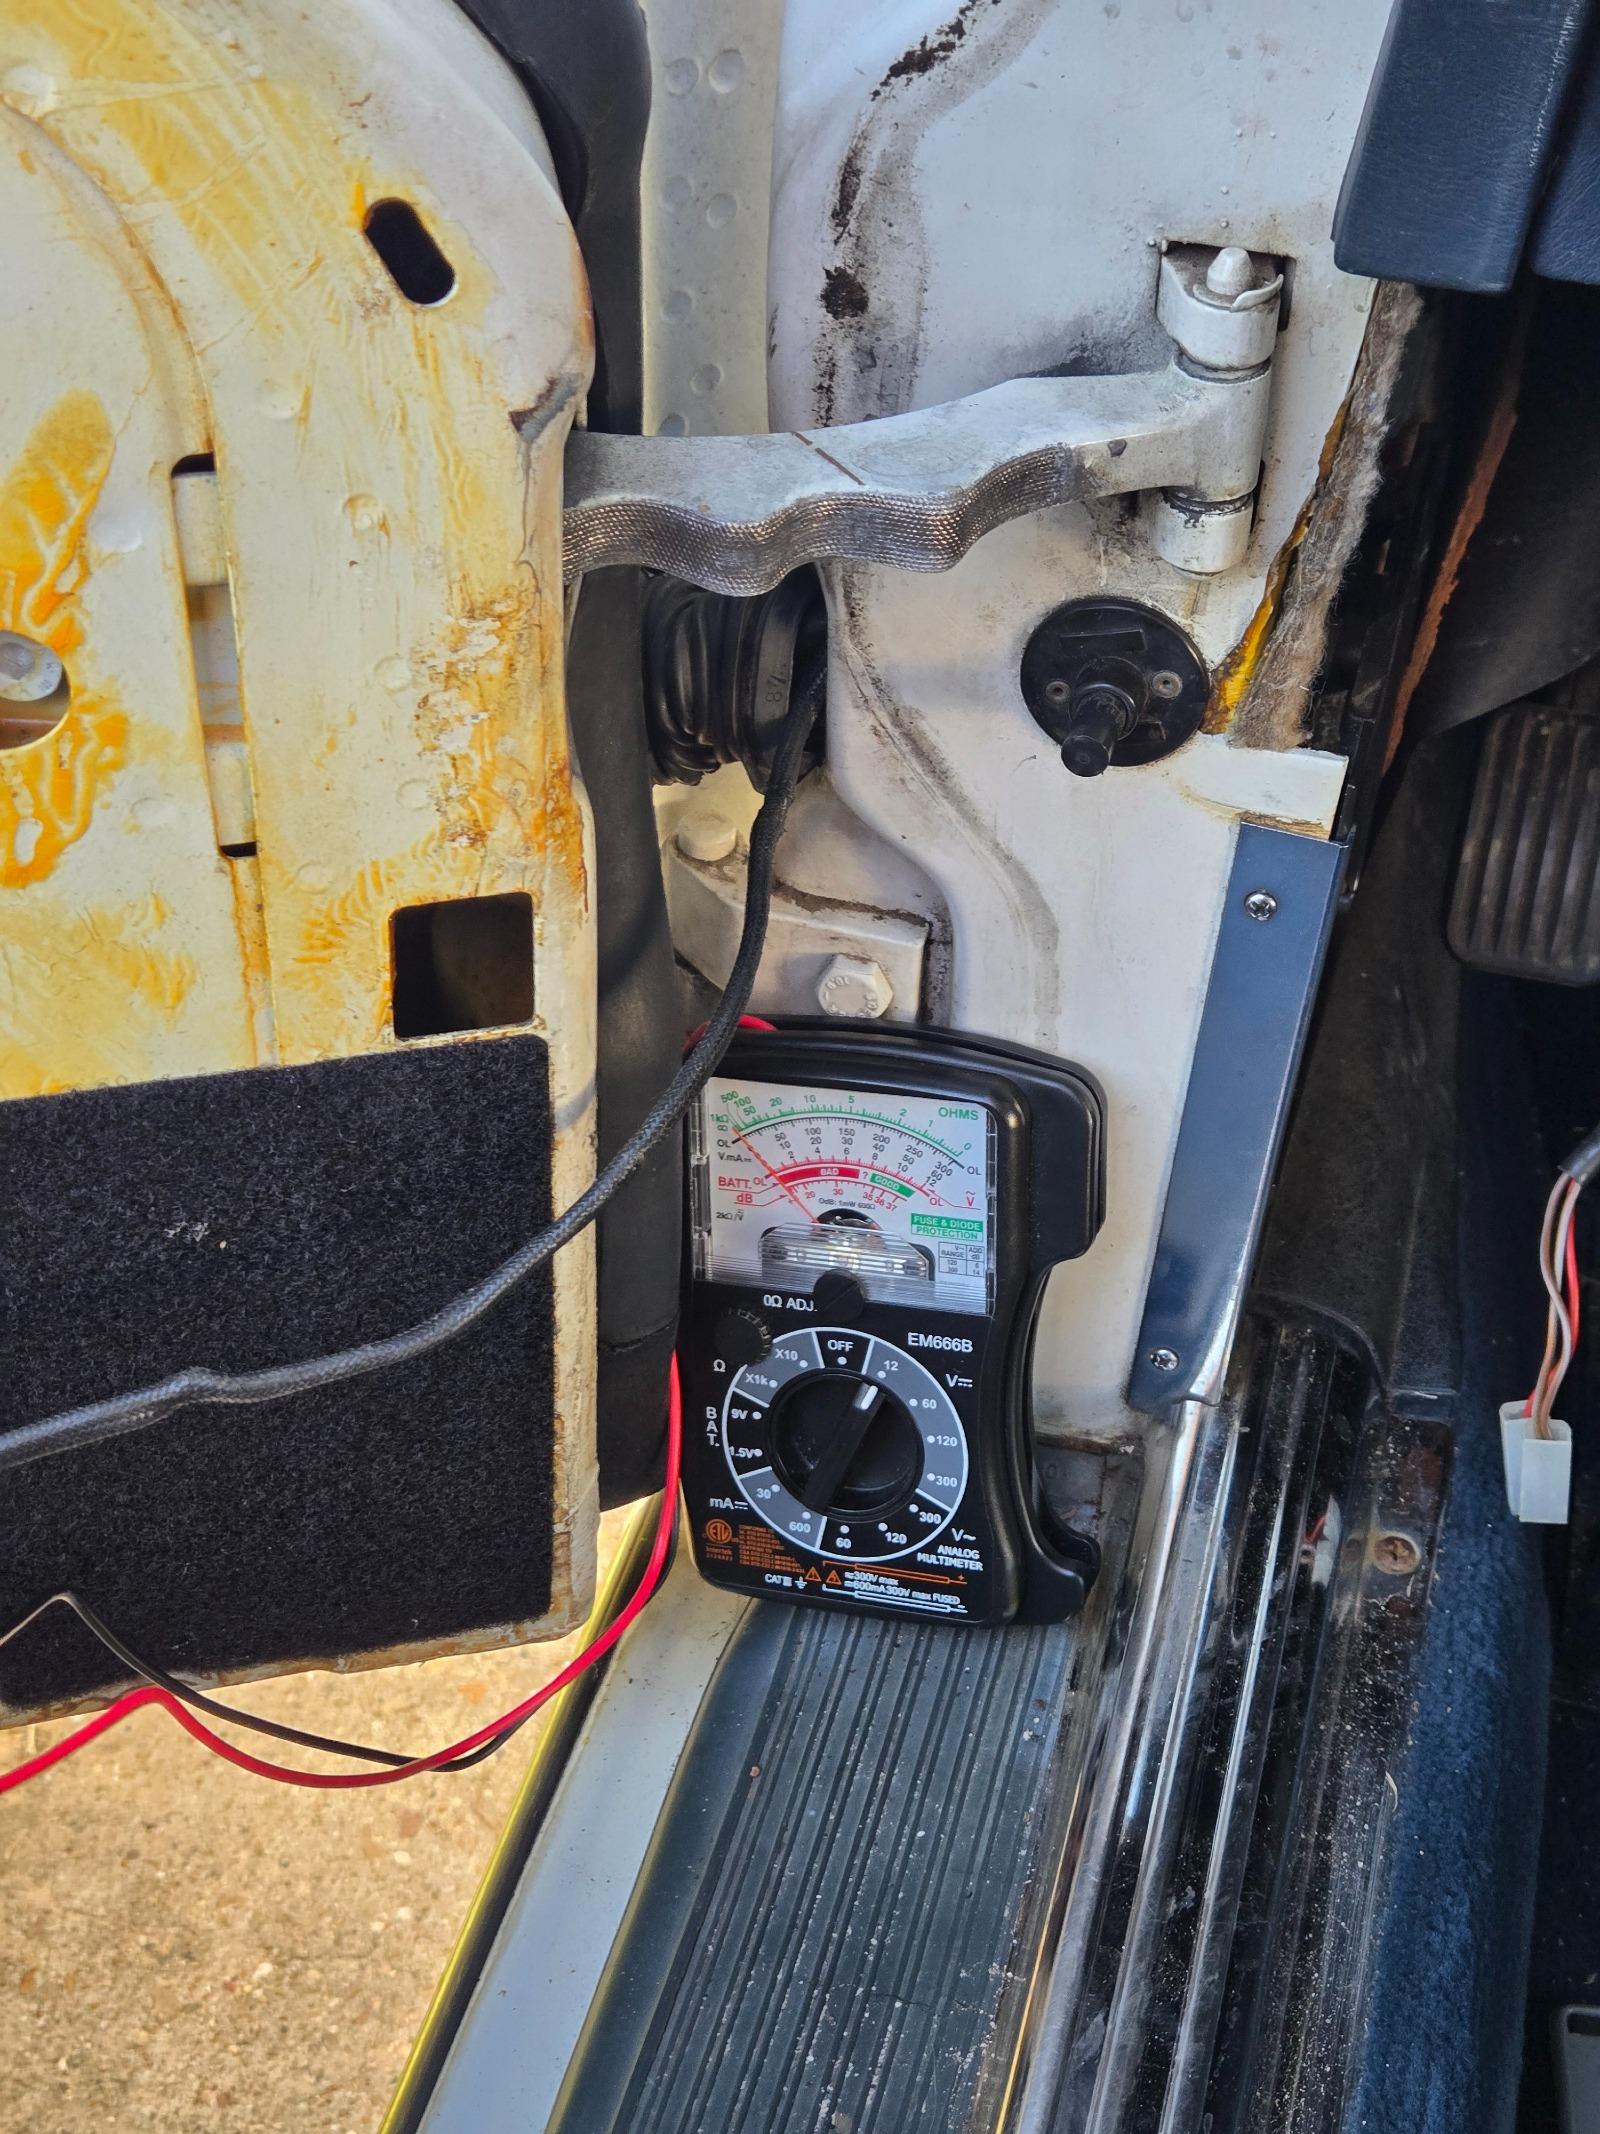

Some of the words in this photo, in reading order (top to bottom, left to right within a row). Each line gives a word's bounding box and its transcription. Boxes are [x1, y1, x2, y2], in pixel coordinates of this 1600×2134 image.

[720, 1091, 739, 1103] 500
[734, 1096, 752, 1108] 100
[743, 1105, 756, 1116] 50
[769, 1097, 783, 1107] 20
[804, 1095, 816, 1103] 10
[848, 1095, 855, 1104] 5
[900, 1108, 908, 1116] 2
[938, 1106, 979, 1121] OHMS
[775, 1132, 787, 1142] 50
[804, 1127, 821, 1136] 100
[839, 1128, 856, 1137] 150
[872, 1133, 891, 1144] 200
[905, 1144, 924, 1158] 250
[934, 1161, 953, 1177] 300
[779, 1141, 791, 1150] 10
[810, 1136, 822, 1145] 20
[841, 1137, 854, 1146] 30
[872, 1142, 885, 1153] 40
[902, 1153, 915, 1165] 50
[930, 1169, 943, 1181] 60
[788, 1150, 795, 1159] 2
[843, 1147, 850, 1156] 6
[872, 1152, 879, 1161] 8
[897, 1162, 909, 1173] 10
[926, 1176, 937, 1187] 12
[718, 1176, 752, 1189] BATT.
[820, 1168, 840, 1176] BAD
[873, 1174, 901, 1191] GOOD
[736, 1193, 753, 1203] dB
[805, 1190, 816, 1199] 20
[832, 1188, 844, 1197] 30
[863, 1191, 873, 1201] 35
[873, 1195, 885, 1206] 36
[886, 1201, 897, 1212] 37
[913, 1215, 939, 1226] FUSE
[941, 1219, 948, 1227] &
[950, 1220, 981, 1231] DIODE
[916, 1226, 978, 1240] PROTECTION
[786, 1298, 818, 1312] ADJ.
[827, 1339, 854, 1352] OFF
[907, 1332, 974, 1353] EM666B
[774, 1348, 798, 1361] X10
[713, 1359, 726, 1373] Ω
[883, 1360, 899, 1371] 12
[745, 1373, 768, 1385] X1k
[921, 1398, 937, 1410] 60
[731, 1408, 748, 1420] 9V
[936, 1435, 958, 1447] 120
[729, 1446, 754, 1459] 1.5V
[935, 1476, 958, 1488] 300
[756, 1487, 772, 1500] 30
[919, 1511, 942, 1525] 300
[789, 1521, 811, 1533] 600
[835, 1537, 852, 1549] 60
[885, 1531, 908, 1545] 120
[937, 1544, 980, 1560] ANALOG
[916, 1552, 984, 1572] MULTIMETER
[911, 1590, 932, 1601] max
[933, 1593, 961, 1606] FUSED
